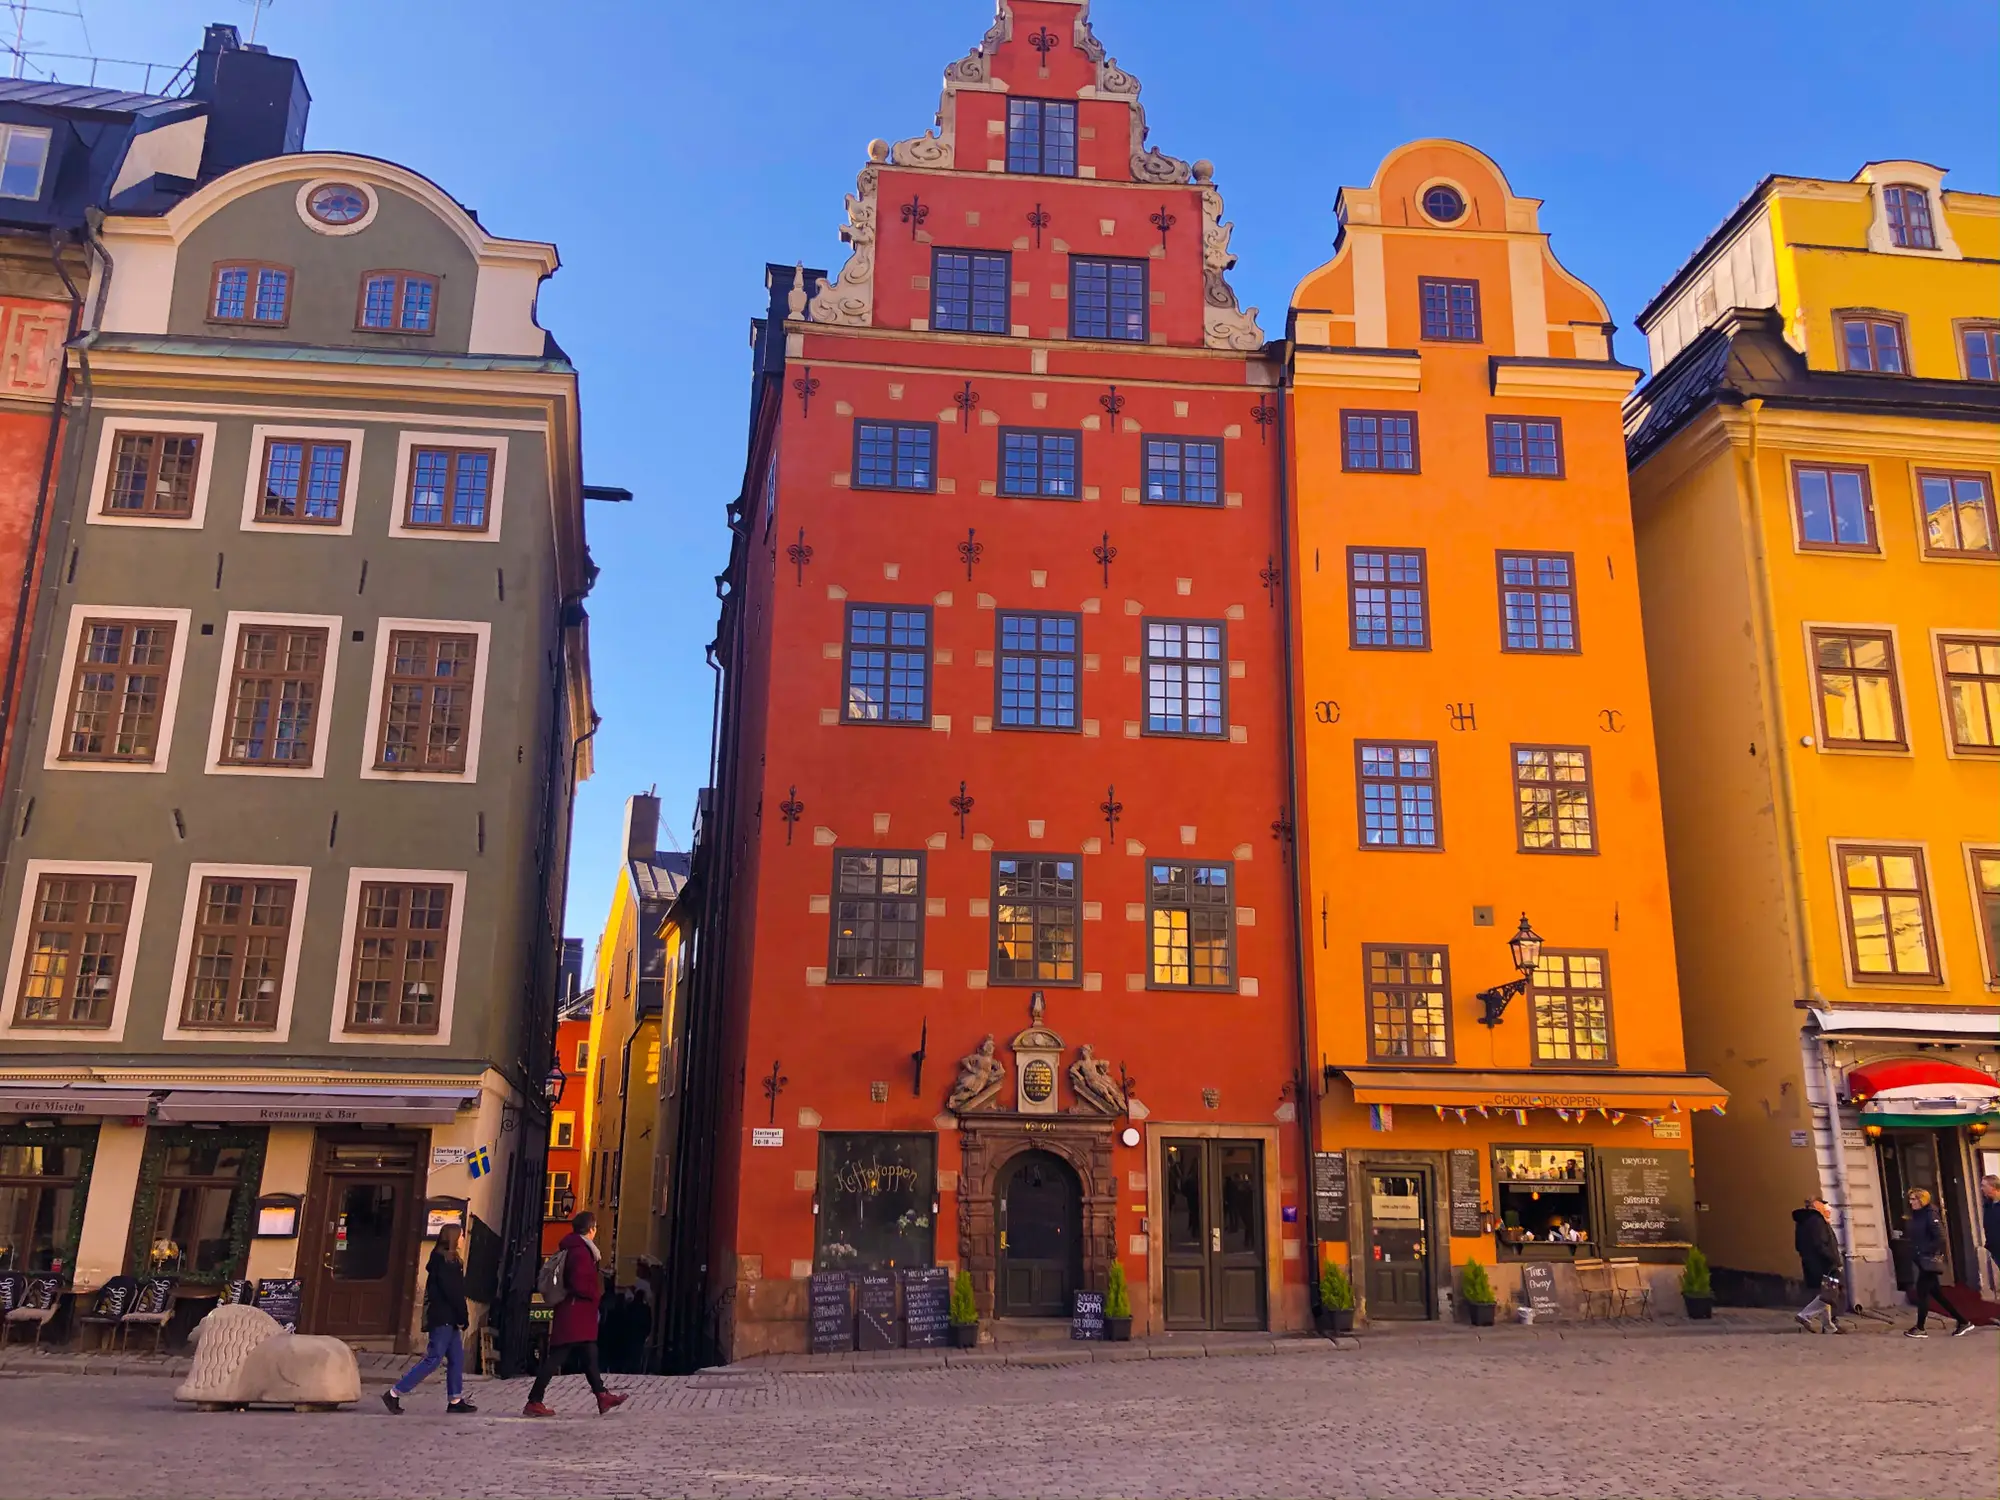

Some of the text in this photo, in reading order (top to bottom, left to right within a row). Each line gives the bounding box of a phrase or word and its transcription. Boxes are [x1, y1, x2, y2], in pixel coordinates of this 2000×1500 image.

[15, 1100, 41, 1111] Café
[260, 1109, 357, 1120] Restaurang & Bar
[1621, 1156, 1660, 1167] DRYCKER
[863, 1276, 889, 1285] Welcome
[1076, 1302, 1102, 1313] SOPPA
